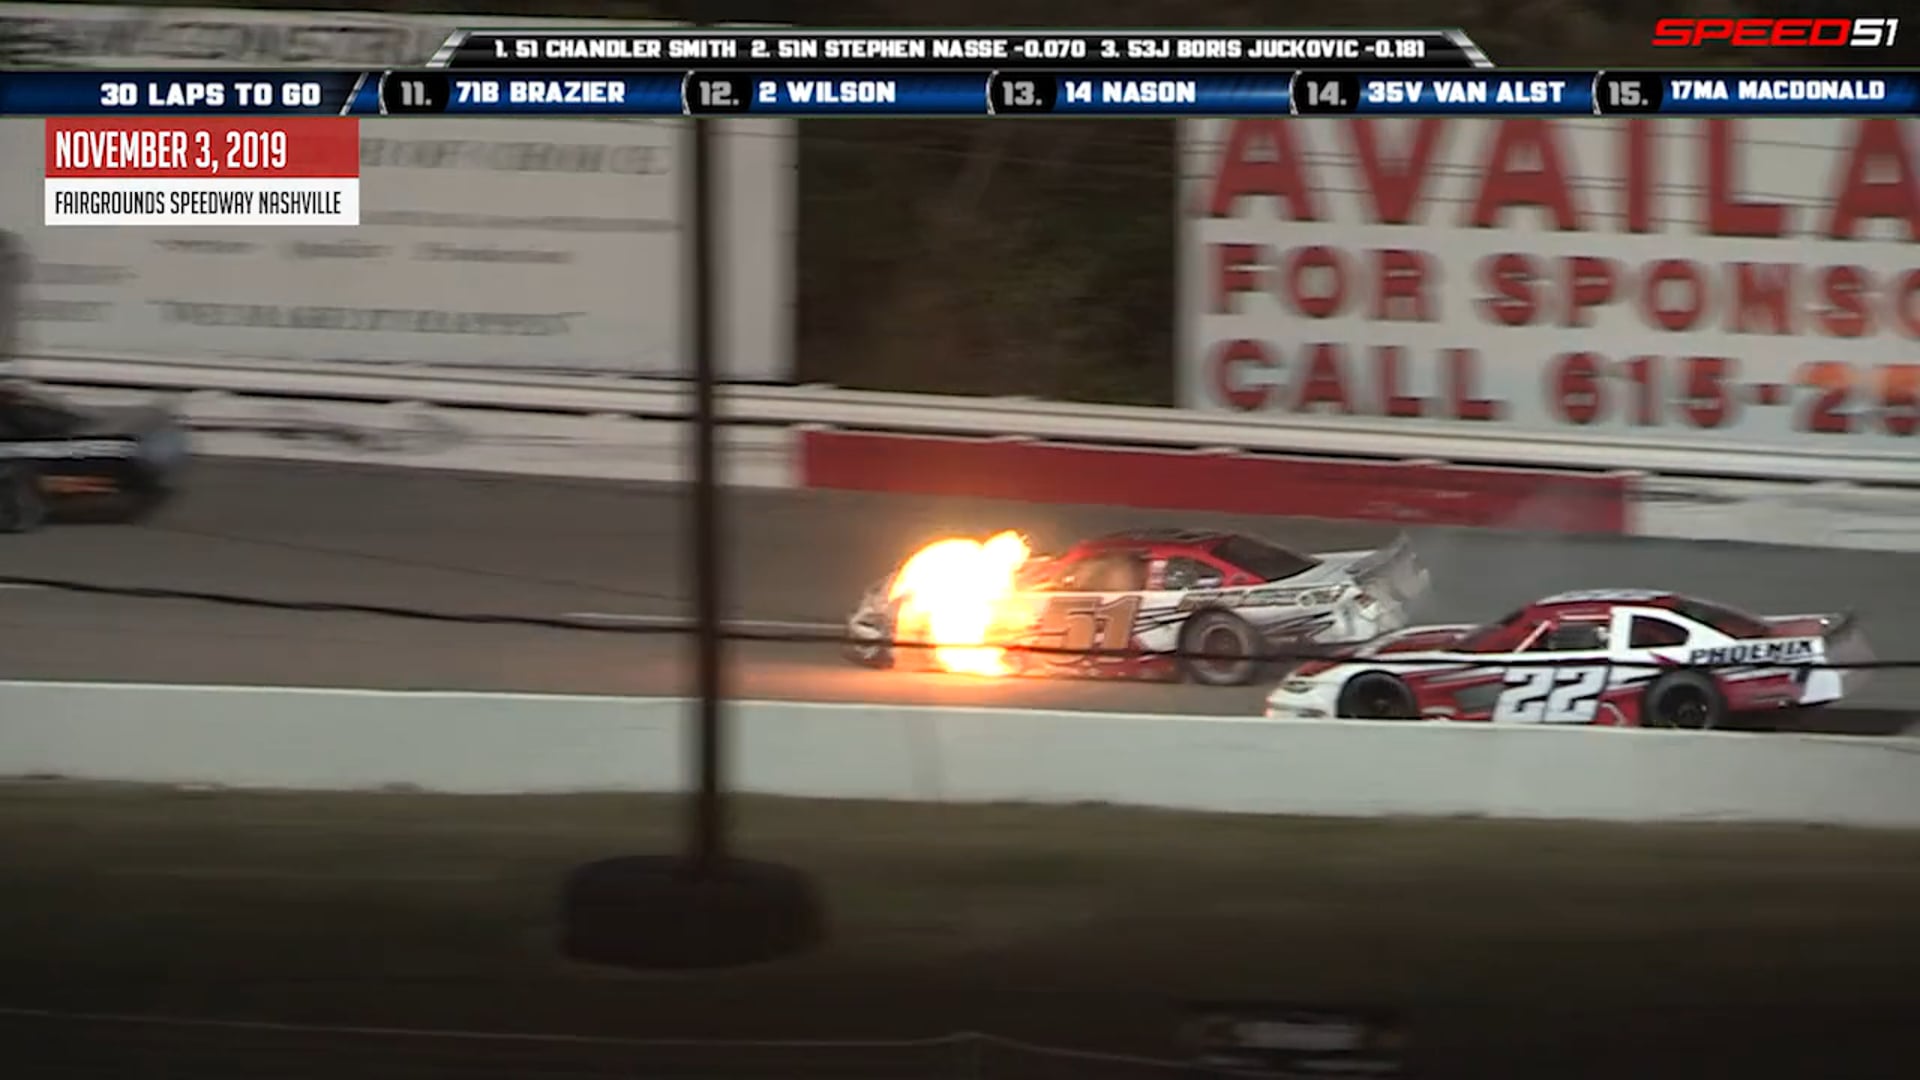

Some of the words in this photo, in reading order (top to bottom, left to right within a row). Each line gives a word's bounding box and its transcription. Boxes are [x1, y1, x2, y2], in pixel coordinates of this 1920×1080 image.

[1205, 242, 1438, 322] FOR
[1207, 339, 1504, 421] CALL
[1037, 595, 1142, 650] 51
[1689, 640, 1812, 663] PHOENIX
[1492, 666, 1609, 723] 22
